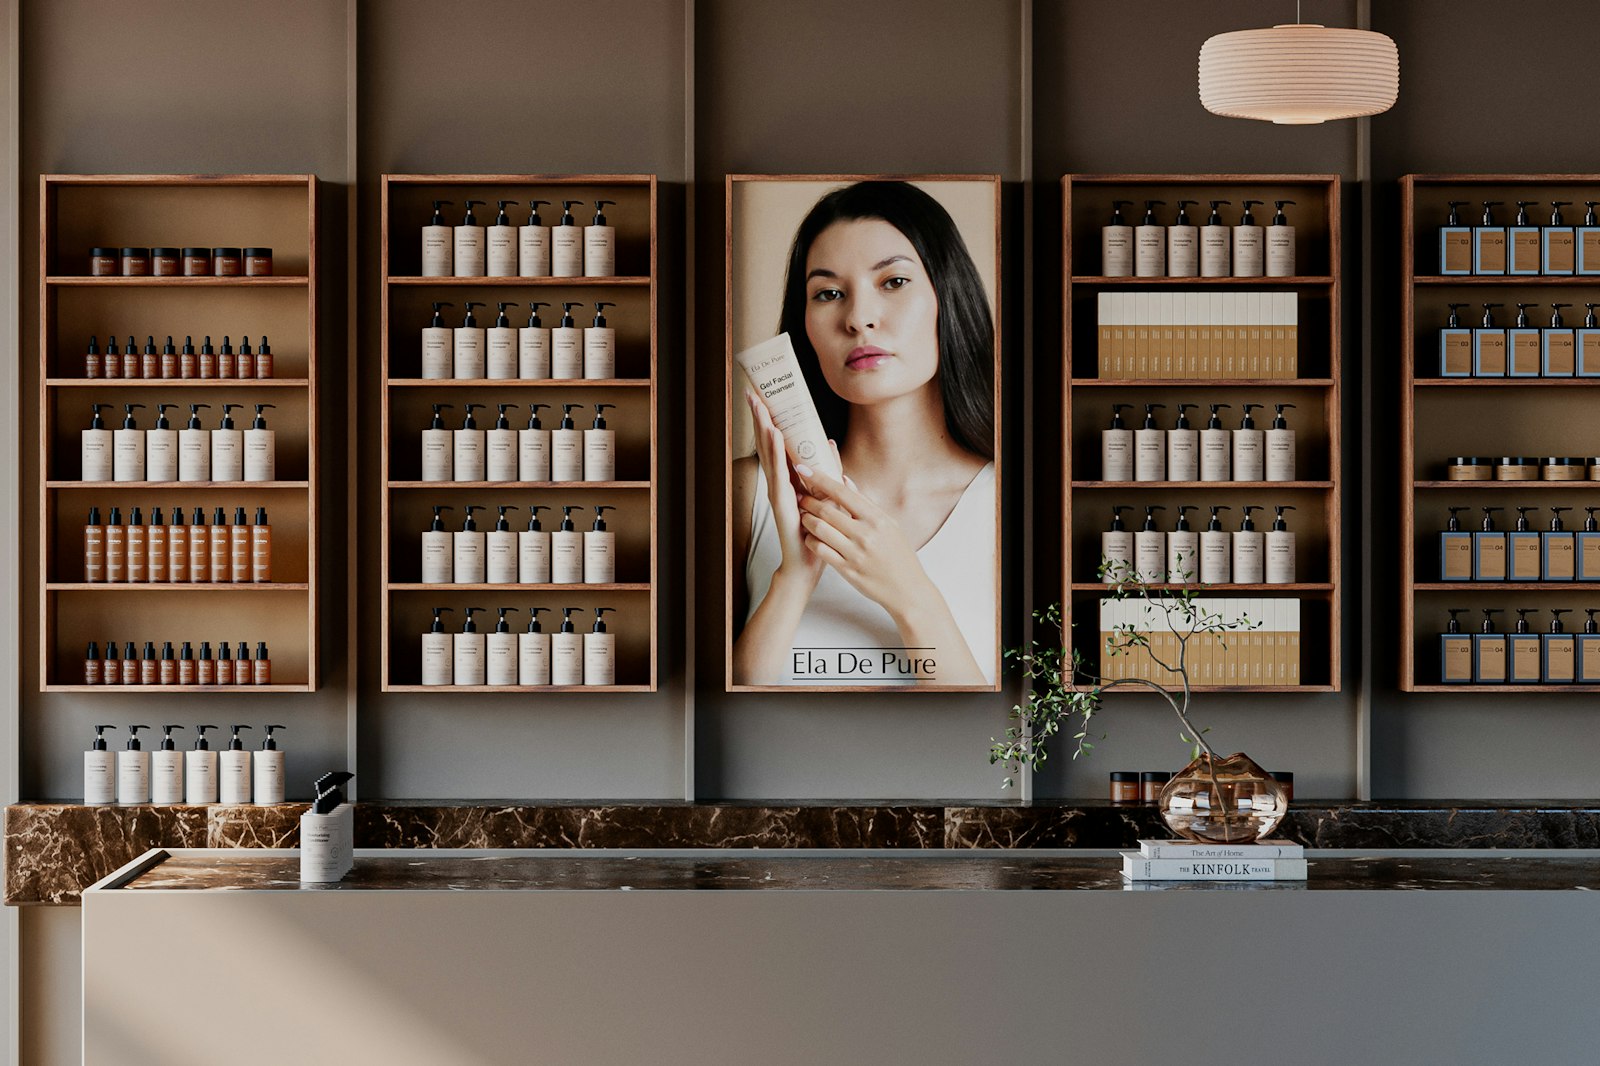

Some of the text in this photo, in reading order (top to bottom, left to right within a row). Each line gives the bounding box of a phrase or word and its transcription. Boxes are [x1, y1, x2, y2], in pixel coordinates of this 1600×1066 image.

[760, 372, 793, 390] Gel Facial
[764, 381, 795, 398] Cleanser
[794, 651, 936, 674] Ela De Pure
[1192, 864, 1250, 875] KINFOLK
